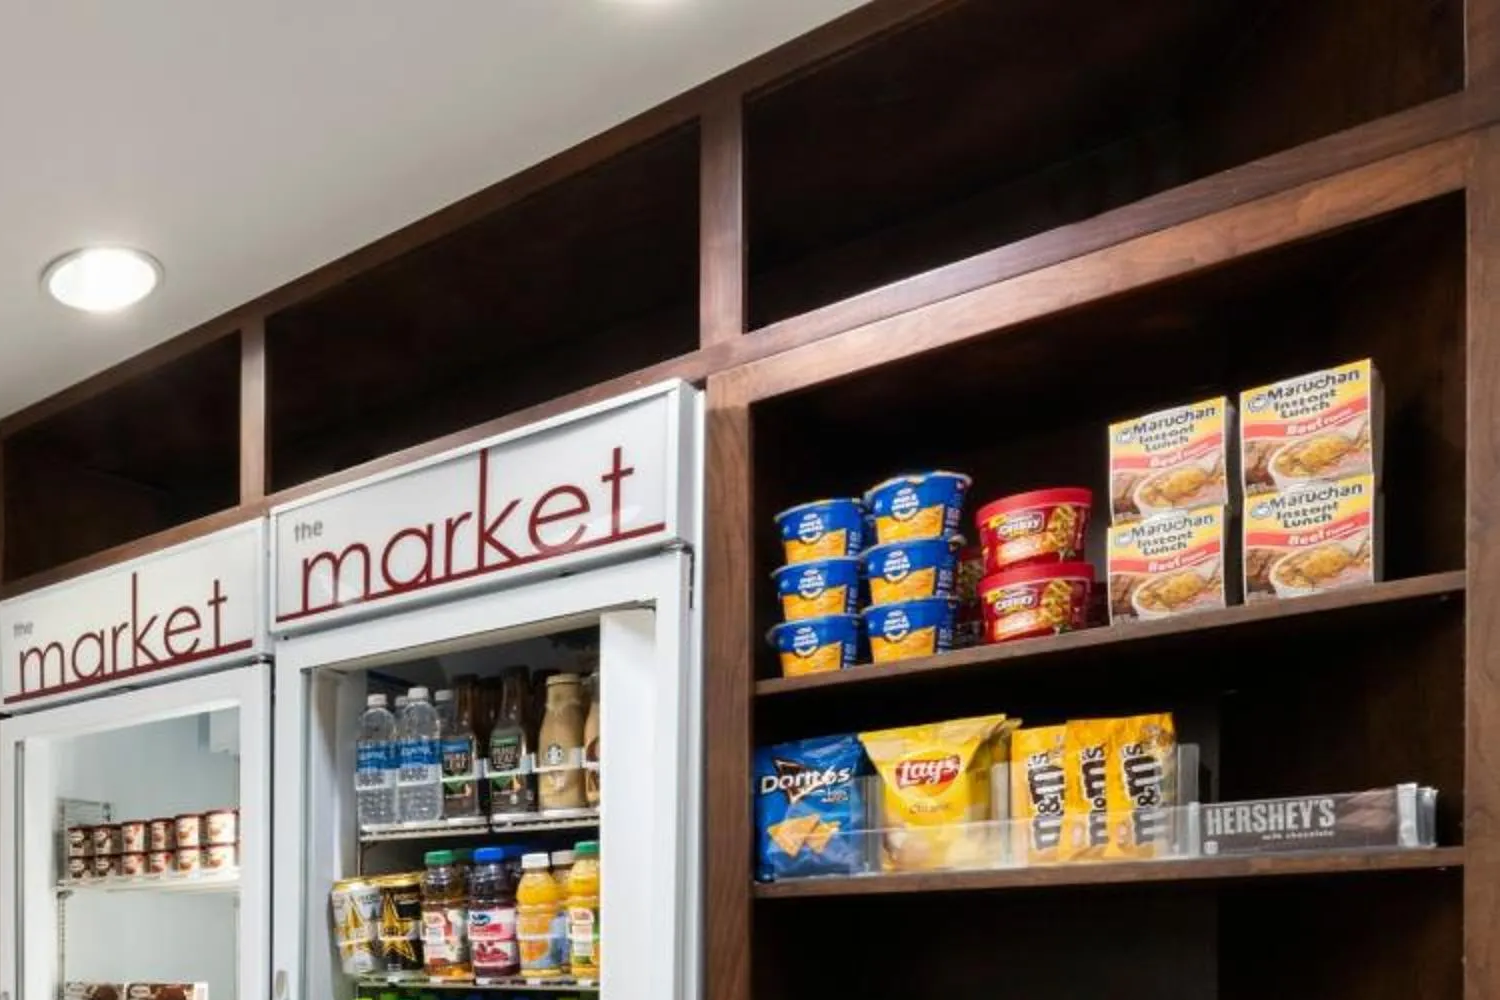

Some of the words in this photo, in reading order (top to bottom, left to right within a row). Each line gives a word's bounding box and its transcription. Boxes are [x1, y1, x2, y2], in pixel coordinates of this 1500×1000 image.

[1267, 368, 1361, 401] Maruchan
[1274, 388, 1337, 411] Instant
[1280, 400, 1331, 419] Lunch
[1132, 405, 1216, 435] Maruchan
[1138, 423, 1195, 444] Instant
[1144, 434, 1189, 452] Lunch
[1269, 481, 1363, 511] Maruchan
[1276, 501, 1339, 520] Instant
[1283, 512, 1332, 528] Lunch
[293, 518, 324, 542] the
[301, 445, 636, 613] market
[1131, 513, 1214, 539] Maruchan
[1137, 531, 1194, 549] Instant
[1142, 541, 1188, 557] Lunch
[19, 570, 230, 694] market
[761, 765, 851, 795] Doritos
[896, 755, 961, 790] Lay's
[1206, 799, 1336, 836] HERSHEY'S
